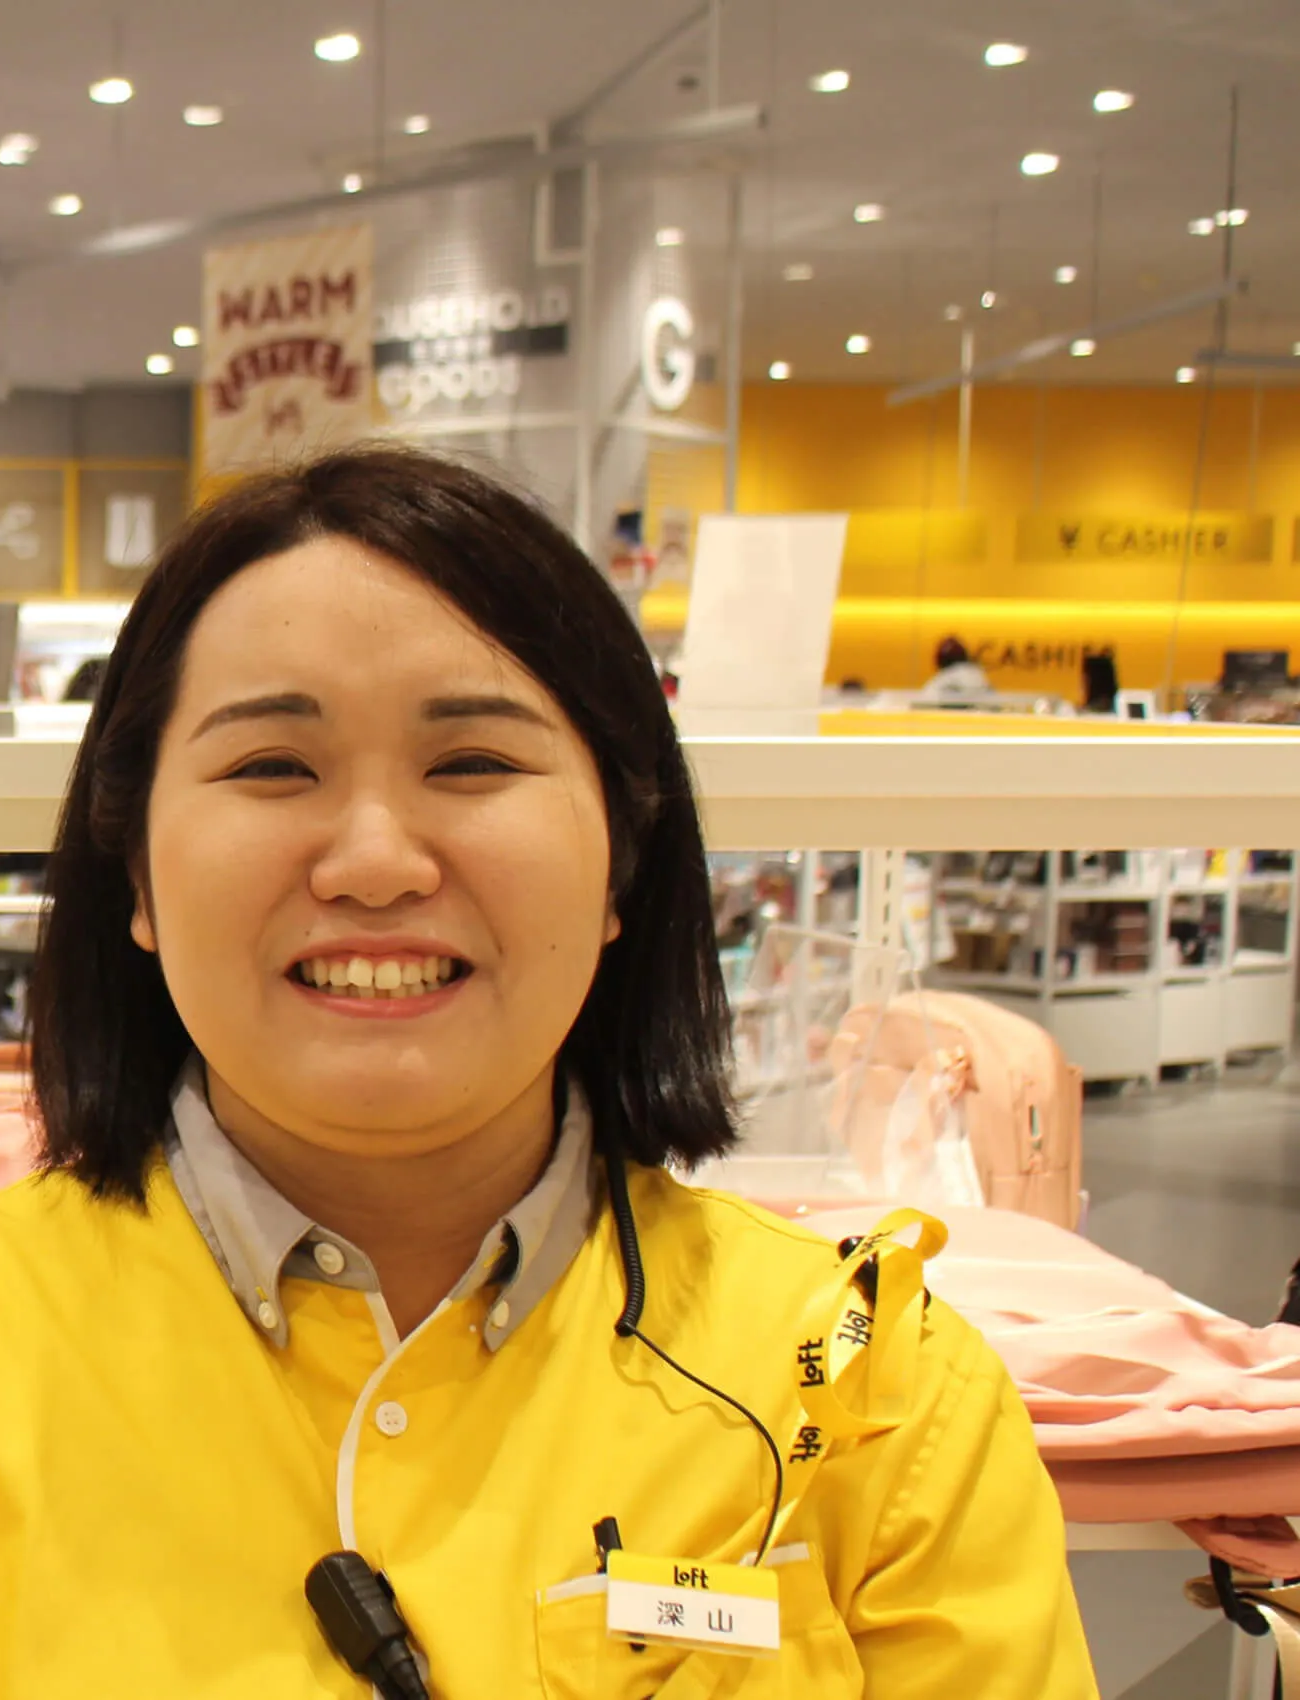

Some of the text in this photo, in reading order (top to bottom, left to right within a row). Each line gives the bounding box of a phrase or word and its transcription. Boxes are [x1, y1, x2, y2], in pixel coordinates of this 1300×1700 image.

[218, 271, 356, 333] WARM
[642, 297, 695, 411] G
[1097, 521, 1228, 556] CASHIER
